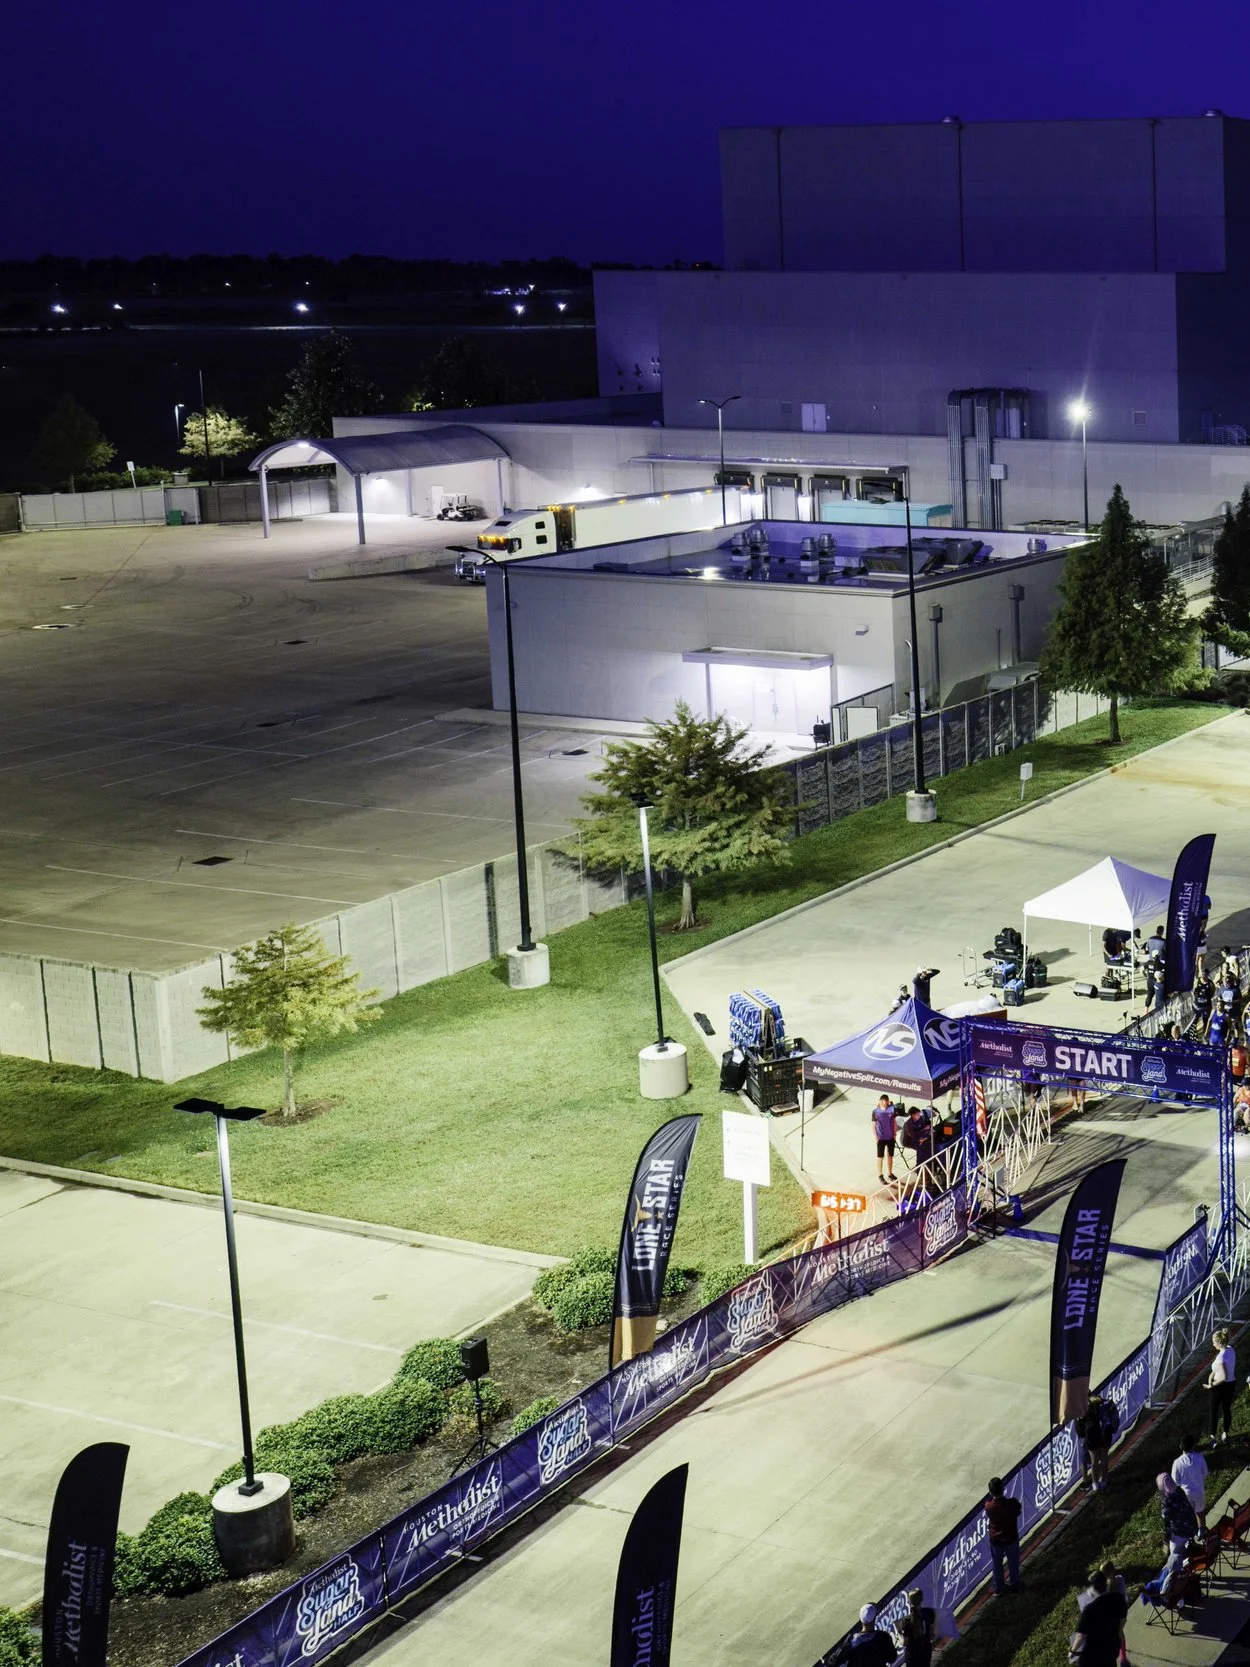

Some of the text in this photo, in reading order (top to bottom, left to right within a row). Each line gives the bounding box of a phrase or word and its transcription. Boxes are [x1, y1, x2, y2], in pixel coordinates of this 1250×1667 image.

[1176, 881, 1194, 942] Methodist
[979, 1042, 1012, 1053] Methodist
[1055, 1046, 1132, 1079] START
[812, 1066, 922, 1092] MyNegativeSplit.com/Results
[1176, 1069, 1210, 1079] Methodist
[631, 1159, 675, 1271] LONE STAR
[928, 1212, 953, 1252] Land
[660, 1225, 672, 1256] RACE
[811, 1239, 890, 1287] Methodist
[1064, 1209, 1101, 1329] LONE STAR
[1089, 1224, 1109, 1313] RACE SERIES
[732, 1292, 767, 1328] Sugar
[733, 1301, 770, 1345] Land
[624, 1337, 696, 1398] Methodist
[541, 1411, 584, 1460] Sugar
[544, 1422, 584, 1479] Land
[566, 1441, 589, 1463] HALF
[403, 1504, 444, 1534] HOUSTON
[406, 1475, 499, 1553] Methodist
[301, 1568, 355, 1629] Sugar
[308, 1564, 348, 1594] Methodist
[62, 1541, 88, 1664] Methodist
[304, 1583, 358, 1651] Land
[333, 1604, 360, 1629] HALF
